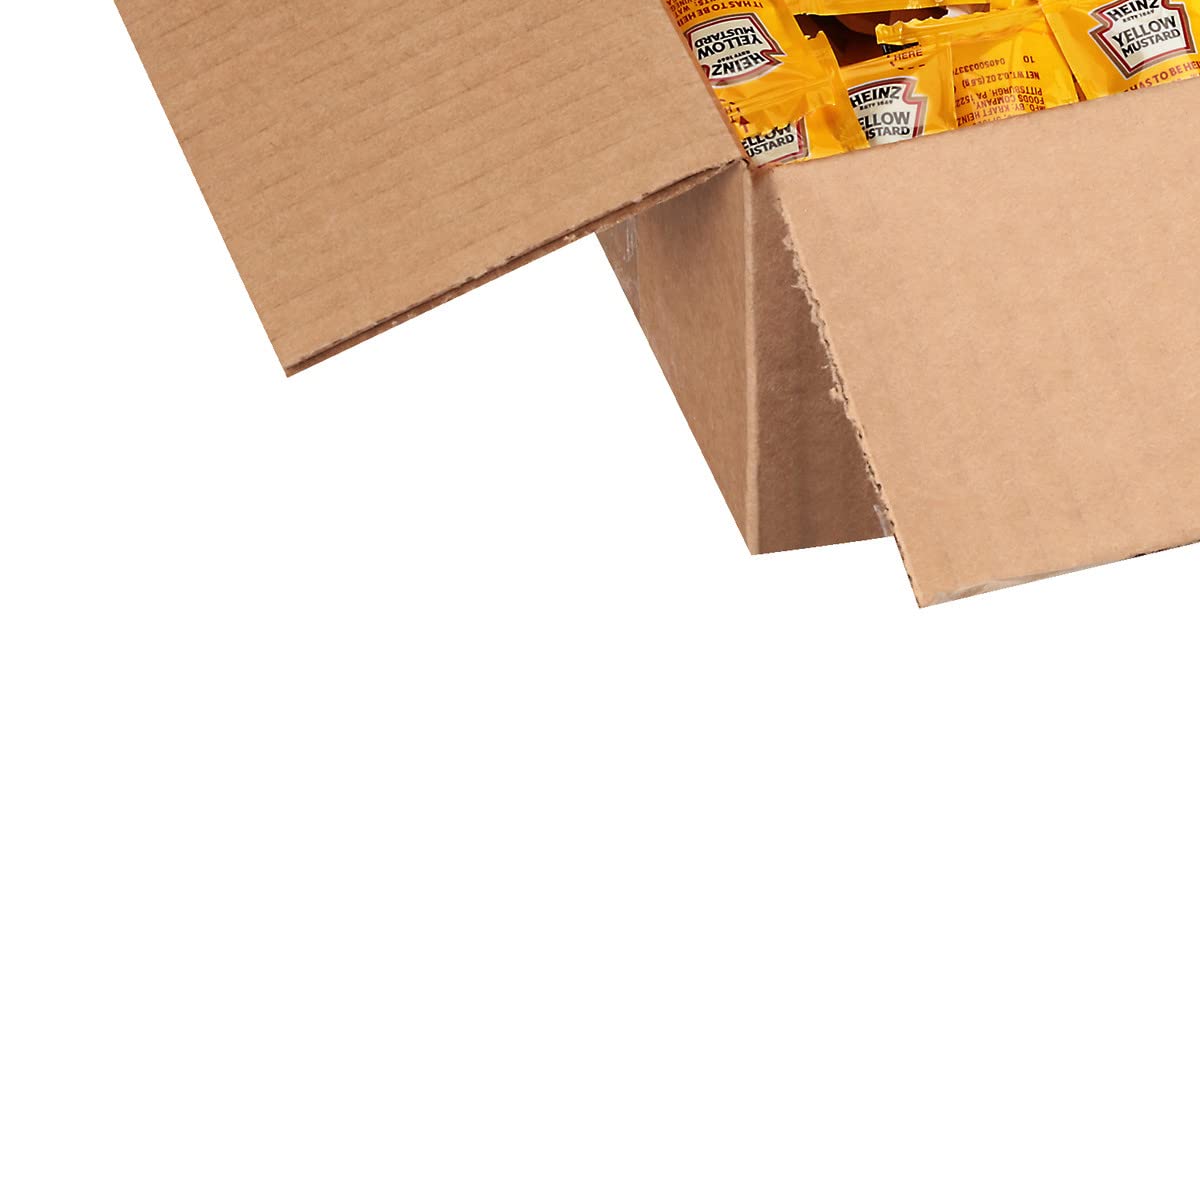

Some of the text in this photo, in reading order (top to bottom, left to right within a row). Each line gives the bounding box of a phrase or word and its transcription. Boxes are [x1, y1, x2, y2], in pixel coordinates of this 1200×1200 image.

[696, 0, 764, 16] IT HAS TO BE
[694, 26, 755, 48] MUSTARD
[1112, 16, 1176, 47] YELLOW
[698, 34, 763, 60] YELLOW
[1121, 29, 1180, 57] MUSTARD
[894, 49, 923, 61] HERE
[1023, 55, 1036, 63] 10
[712, 53, 766, 76] HEINZ
[986, 75, 997, 83] OZ
[1026, 71, 1041, 80] NET
[1152, 72, 1168, 83] TO
[1169, 66, 1183, 76] BE
[850, 86, 902, 108] HEINZ
[976, 91, 988, 99] PA
[1018, 94, 1045, 105] FOODS
[858, 112, 910, 131] ELLOW
[746, 134, 795, 157] USTARD
